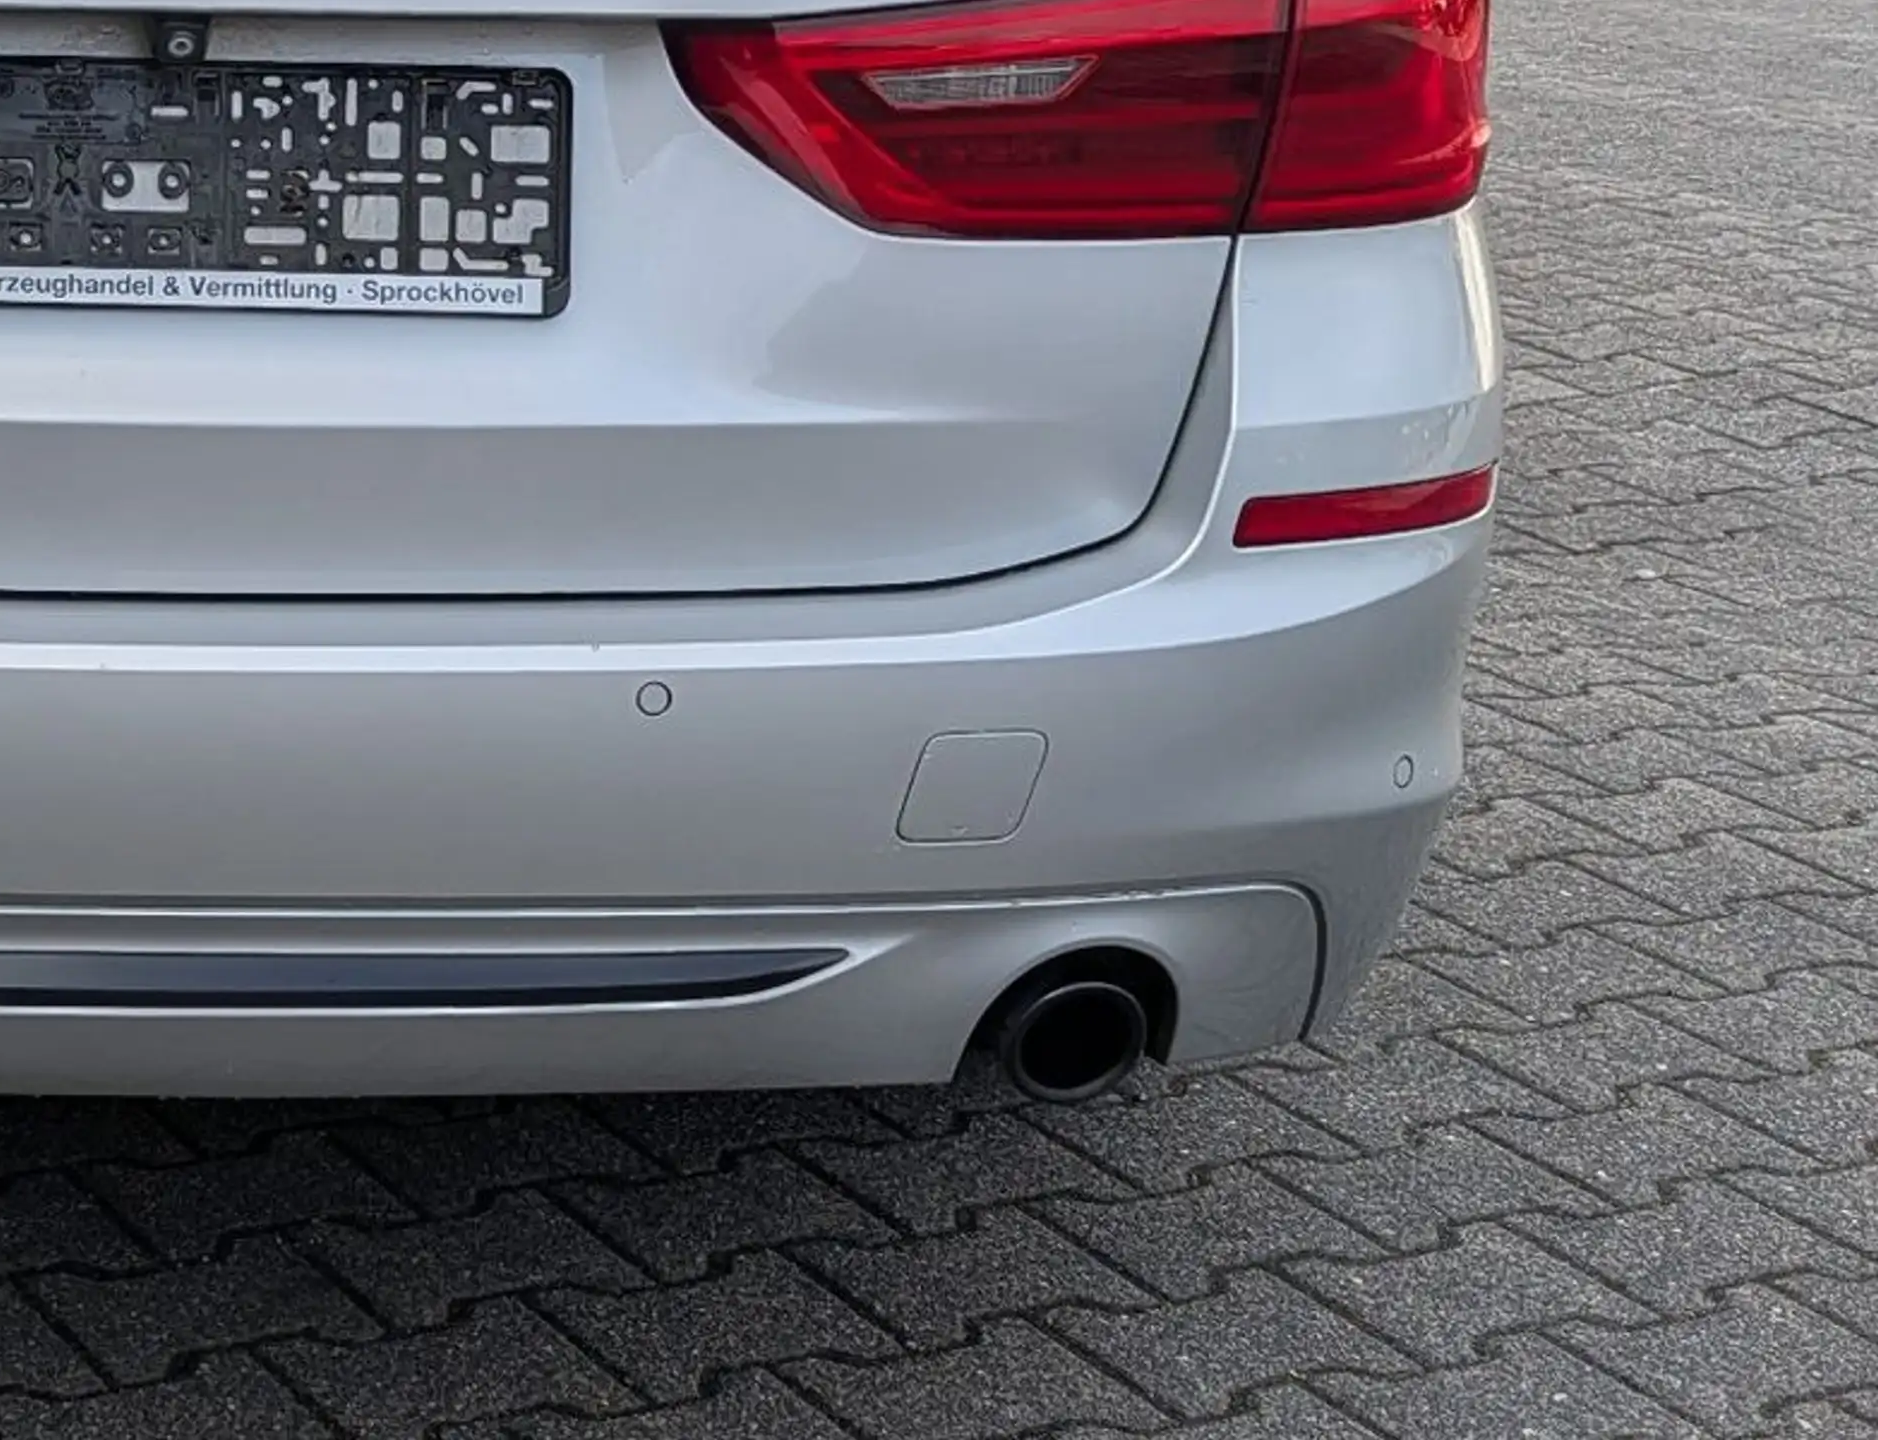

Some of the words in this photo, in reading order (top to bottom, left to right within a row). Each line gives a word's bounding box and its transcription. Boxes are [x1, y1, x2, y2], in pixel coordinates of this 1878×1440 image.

[163, 274, 181, 298] &
[188, 276, 337, 305] Vermittlung
[361, 280, 524, 307] Sprockhövel
